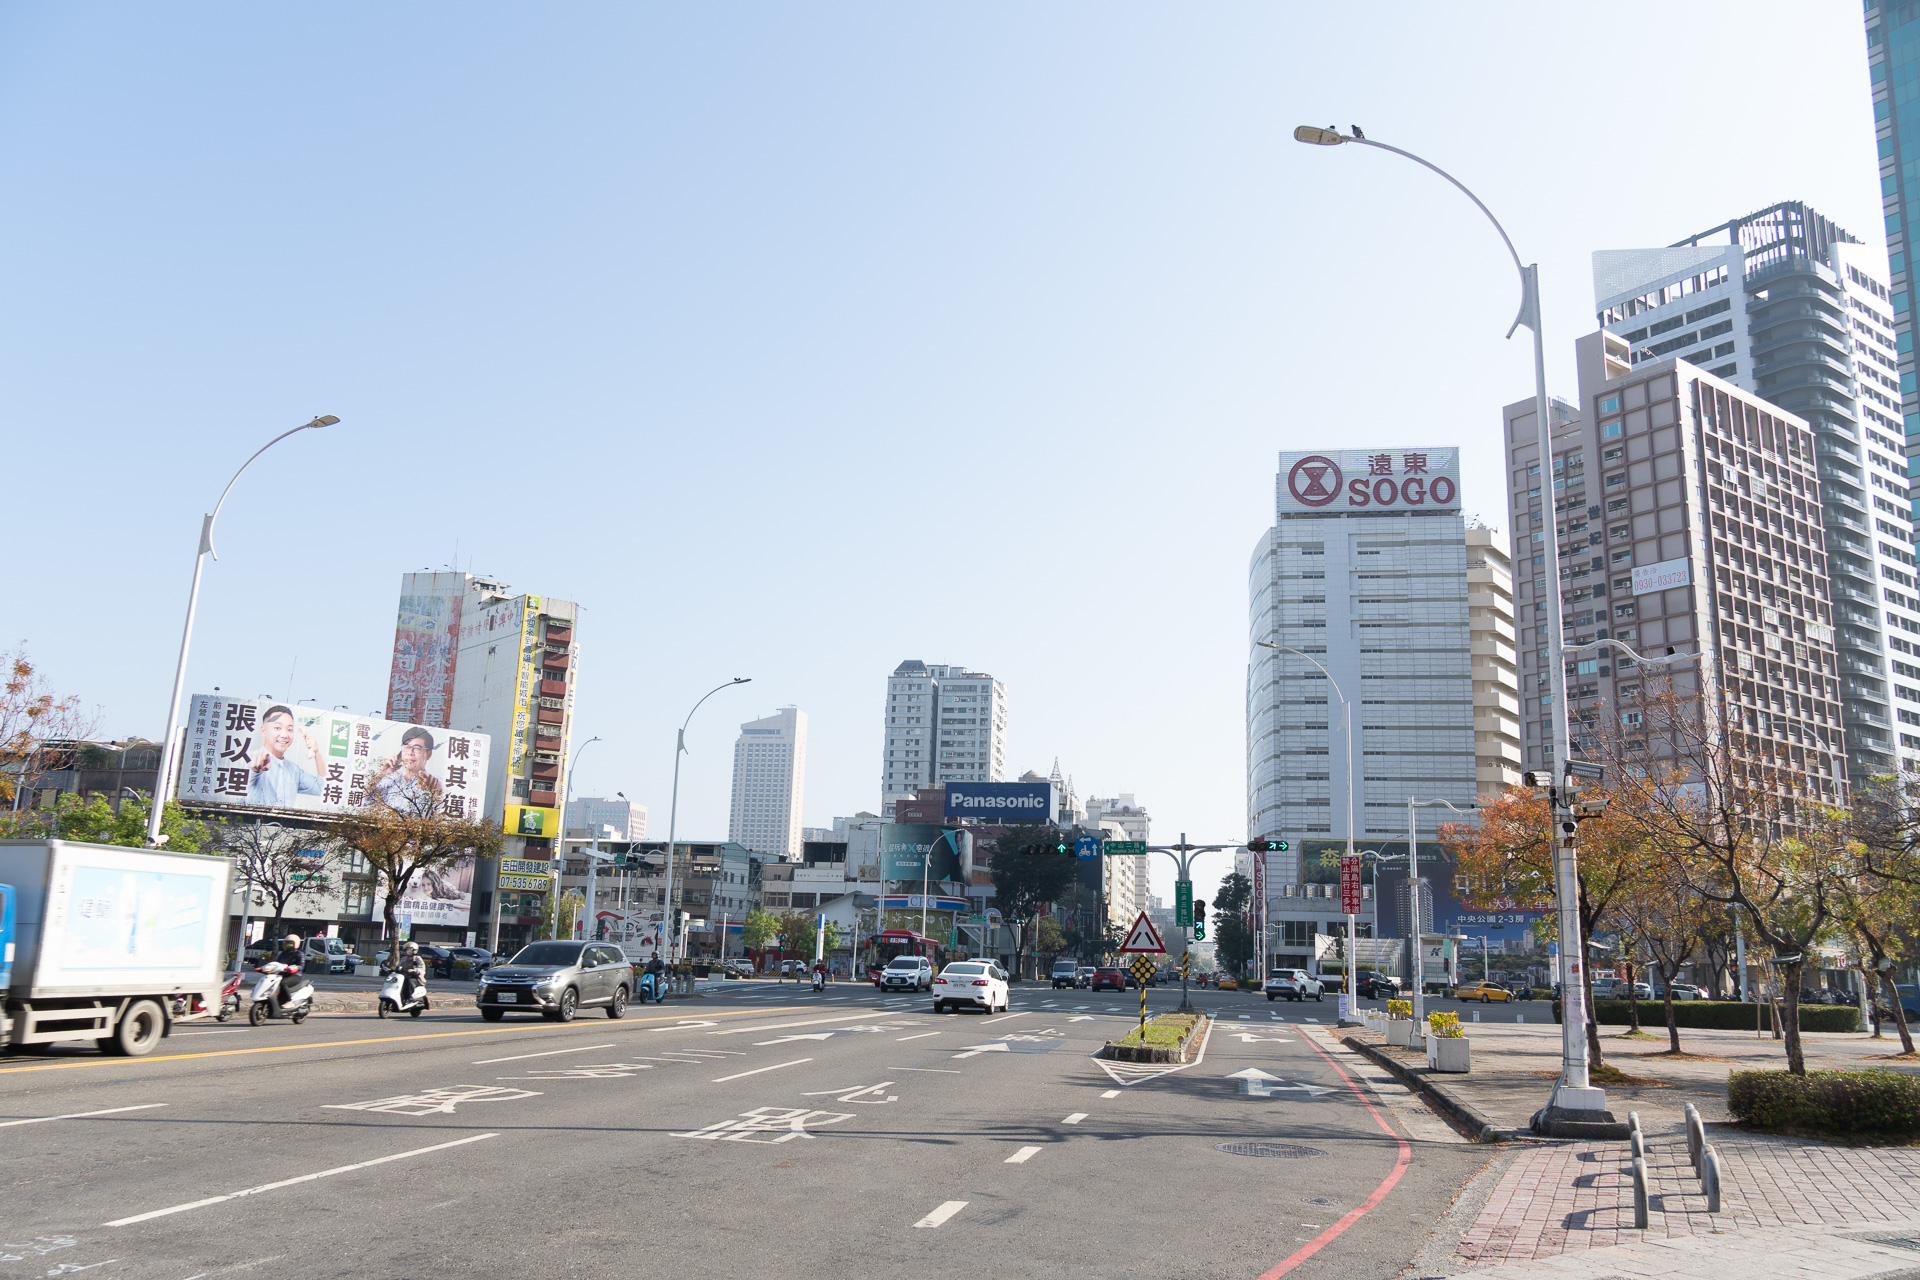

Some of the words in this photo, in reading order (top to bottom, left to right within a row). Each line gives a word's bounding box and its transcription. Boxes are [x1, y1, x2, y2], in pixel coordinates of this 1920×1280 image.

[1368, 453, 1428, 476] 遠東
[1348, 476, 1456, 507] SOGO
[1634, 570, 1687, 592] 0930-033723
[201, 701, 222, 794] 前高雄市政府青年局長
[214, 703, 257, 797] 張以理
[354, 723, 371, 757] 電話
[471, 739, 482, 778] 高雄市長
[323, 762, 345, 805] 支持
[347, 773, 365, 807] 民調
[443, 736, 470, 819] 陳其邁
[950, 793, 1045, 808] Panasonic
[502, 859, 549, 875] 吉田開發建設
[1256, 872, 1264, 908] SOGO
[1342, 858, 1351, 914] 禁止直行三多路
[1351, 857, 1360, 914] 分隔島右側車道
[1457, 915, 1497, 924] 中央公園
[1498, 915, 1525, 924] 2-3房
